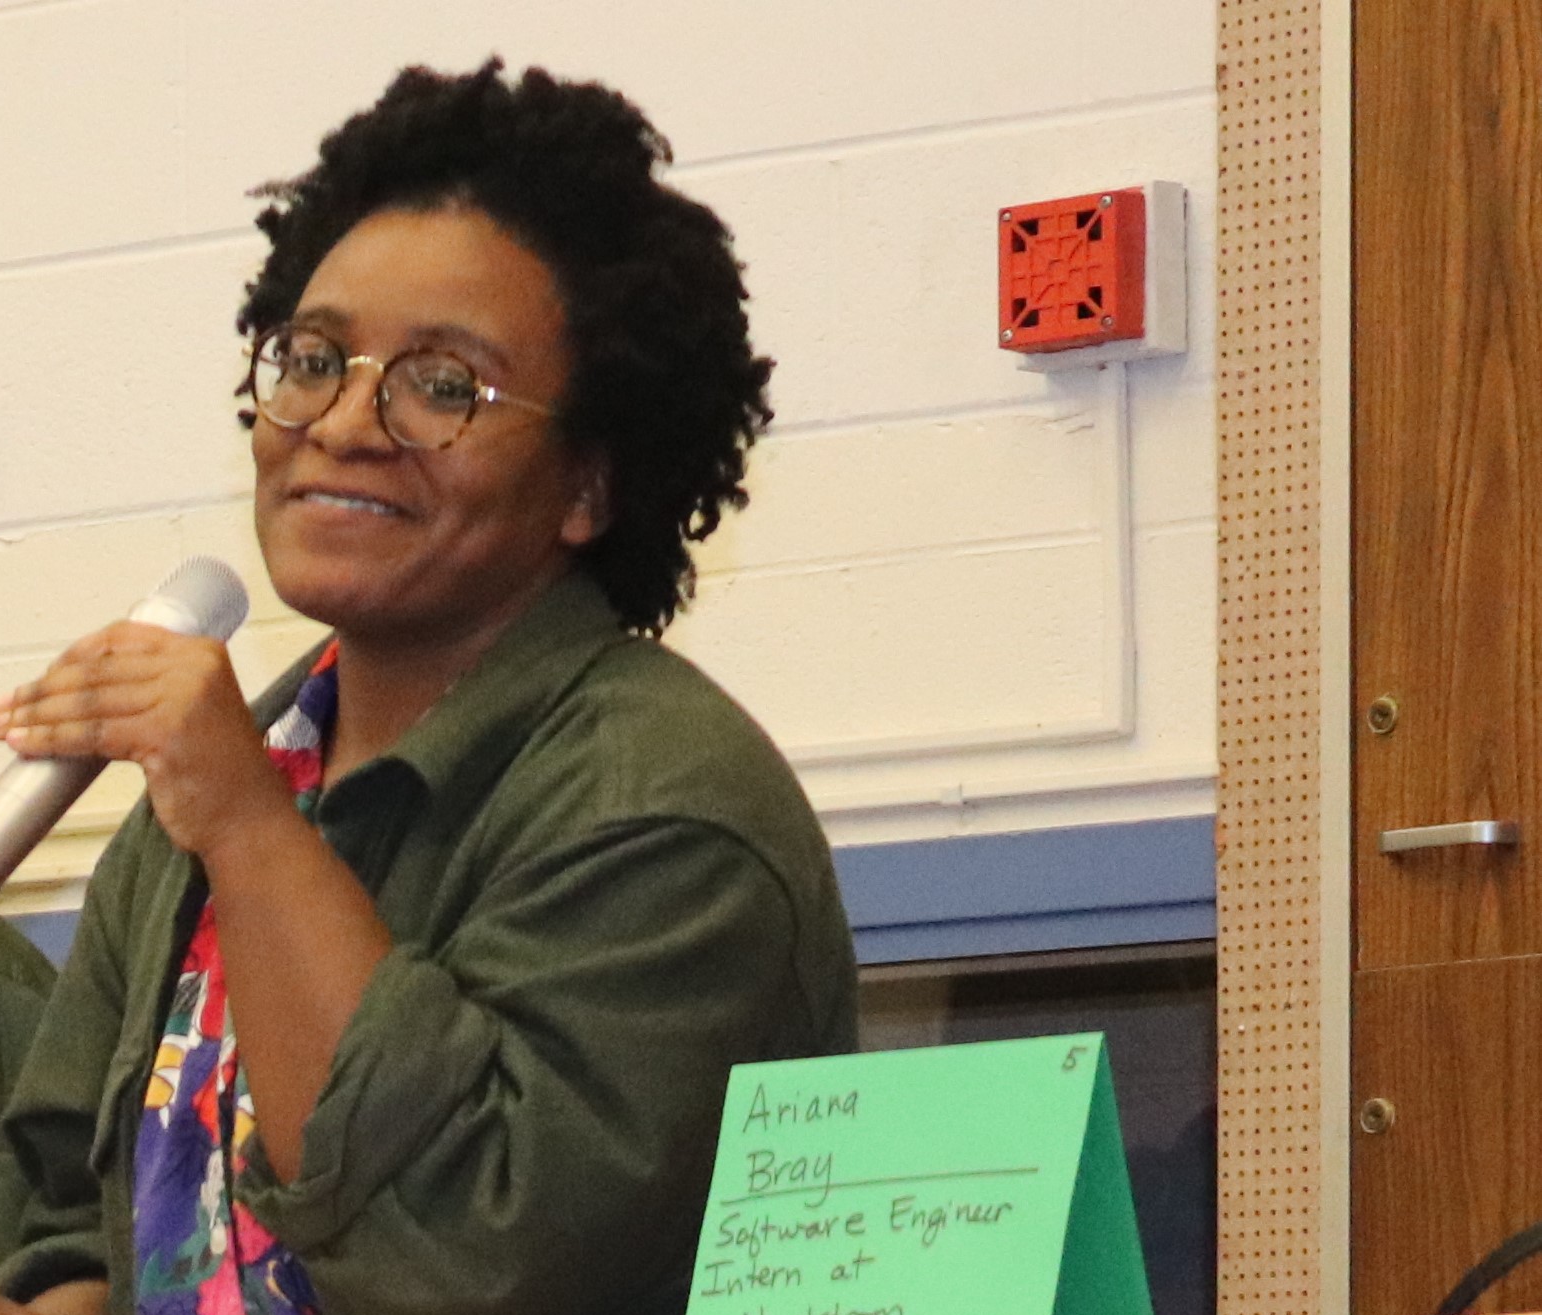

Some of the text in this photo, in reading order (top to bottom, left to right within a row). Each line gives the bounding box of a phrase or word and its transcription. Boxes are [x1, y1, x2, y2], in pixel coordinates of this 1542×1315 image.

[1061, 1046, 1088, 1073] 5
[742, 1083, 860, 1133] Ariana
[746, 1151, 833, 1208] Bray
[715, 1197, 1014, 1259] Software Engineer
[701, 1250, 877, 1297] Intern at
